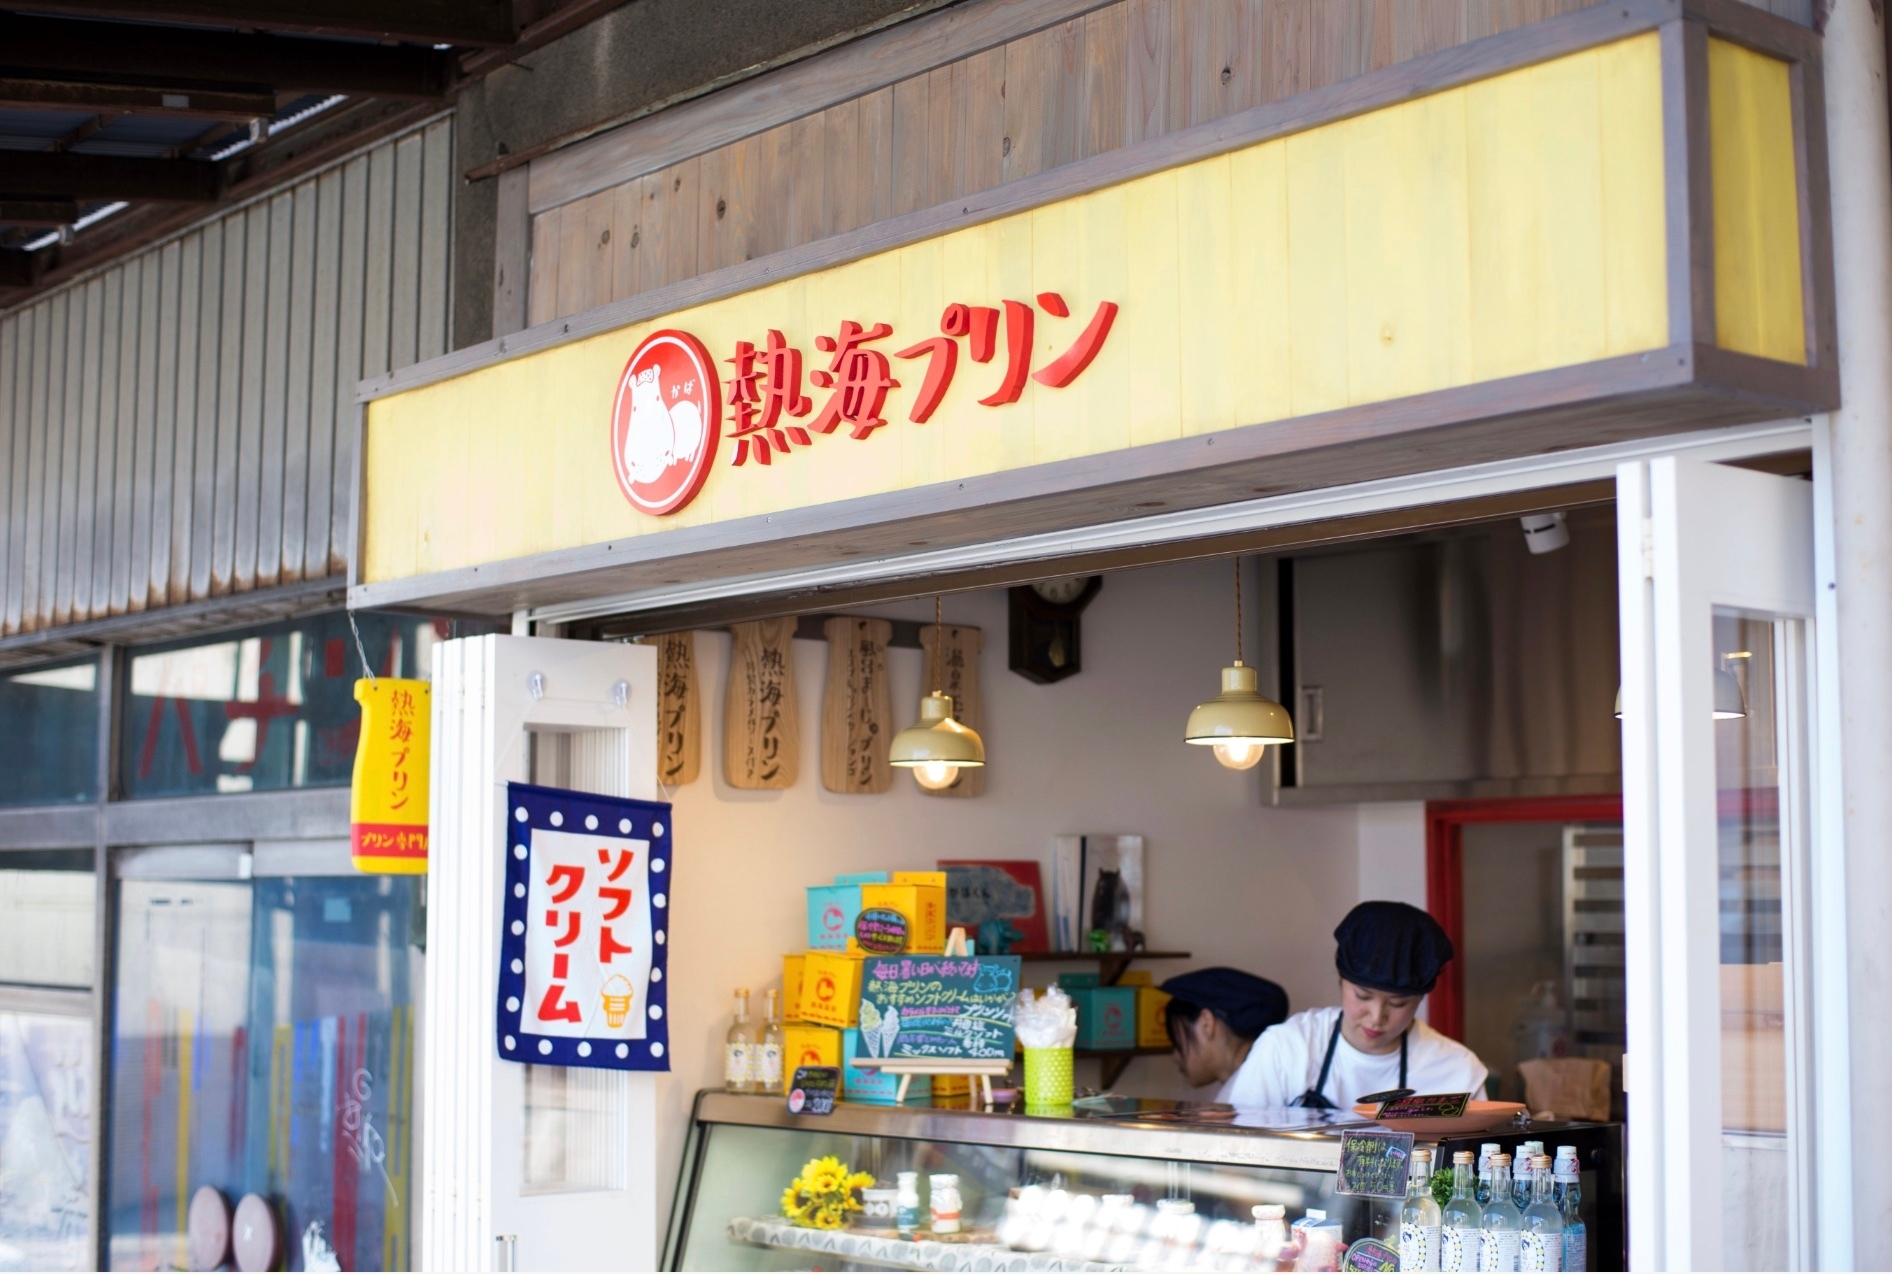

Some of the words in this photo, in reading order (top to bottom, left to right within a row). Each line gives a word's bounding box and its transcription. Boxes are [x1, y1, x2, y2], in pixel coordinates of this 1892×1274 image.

[671, 379, 696, 397] かば
[725, 292, 1118, 466] 熱海プリン
[390, 689, 415, 810] 熱海プリン
[665, 640, 690, 776] 熱海プリン
[760, 647, 785, 780] 熱海プリン
[537, 864, 586, 1024] クリーム
[598, 848, 635, 964] ソフト
[868, 980, 942, 994] 熱海プリンの
